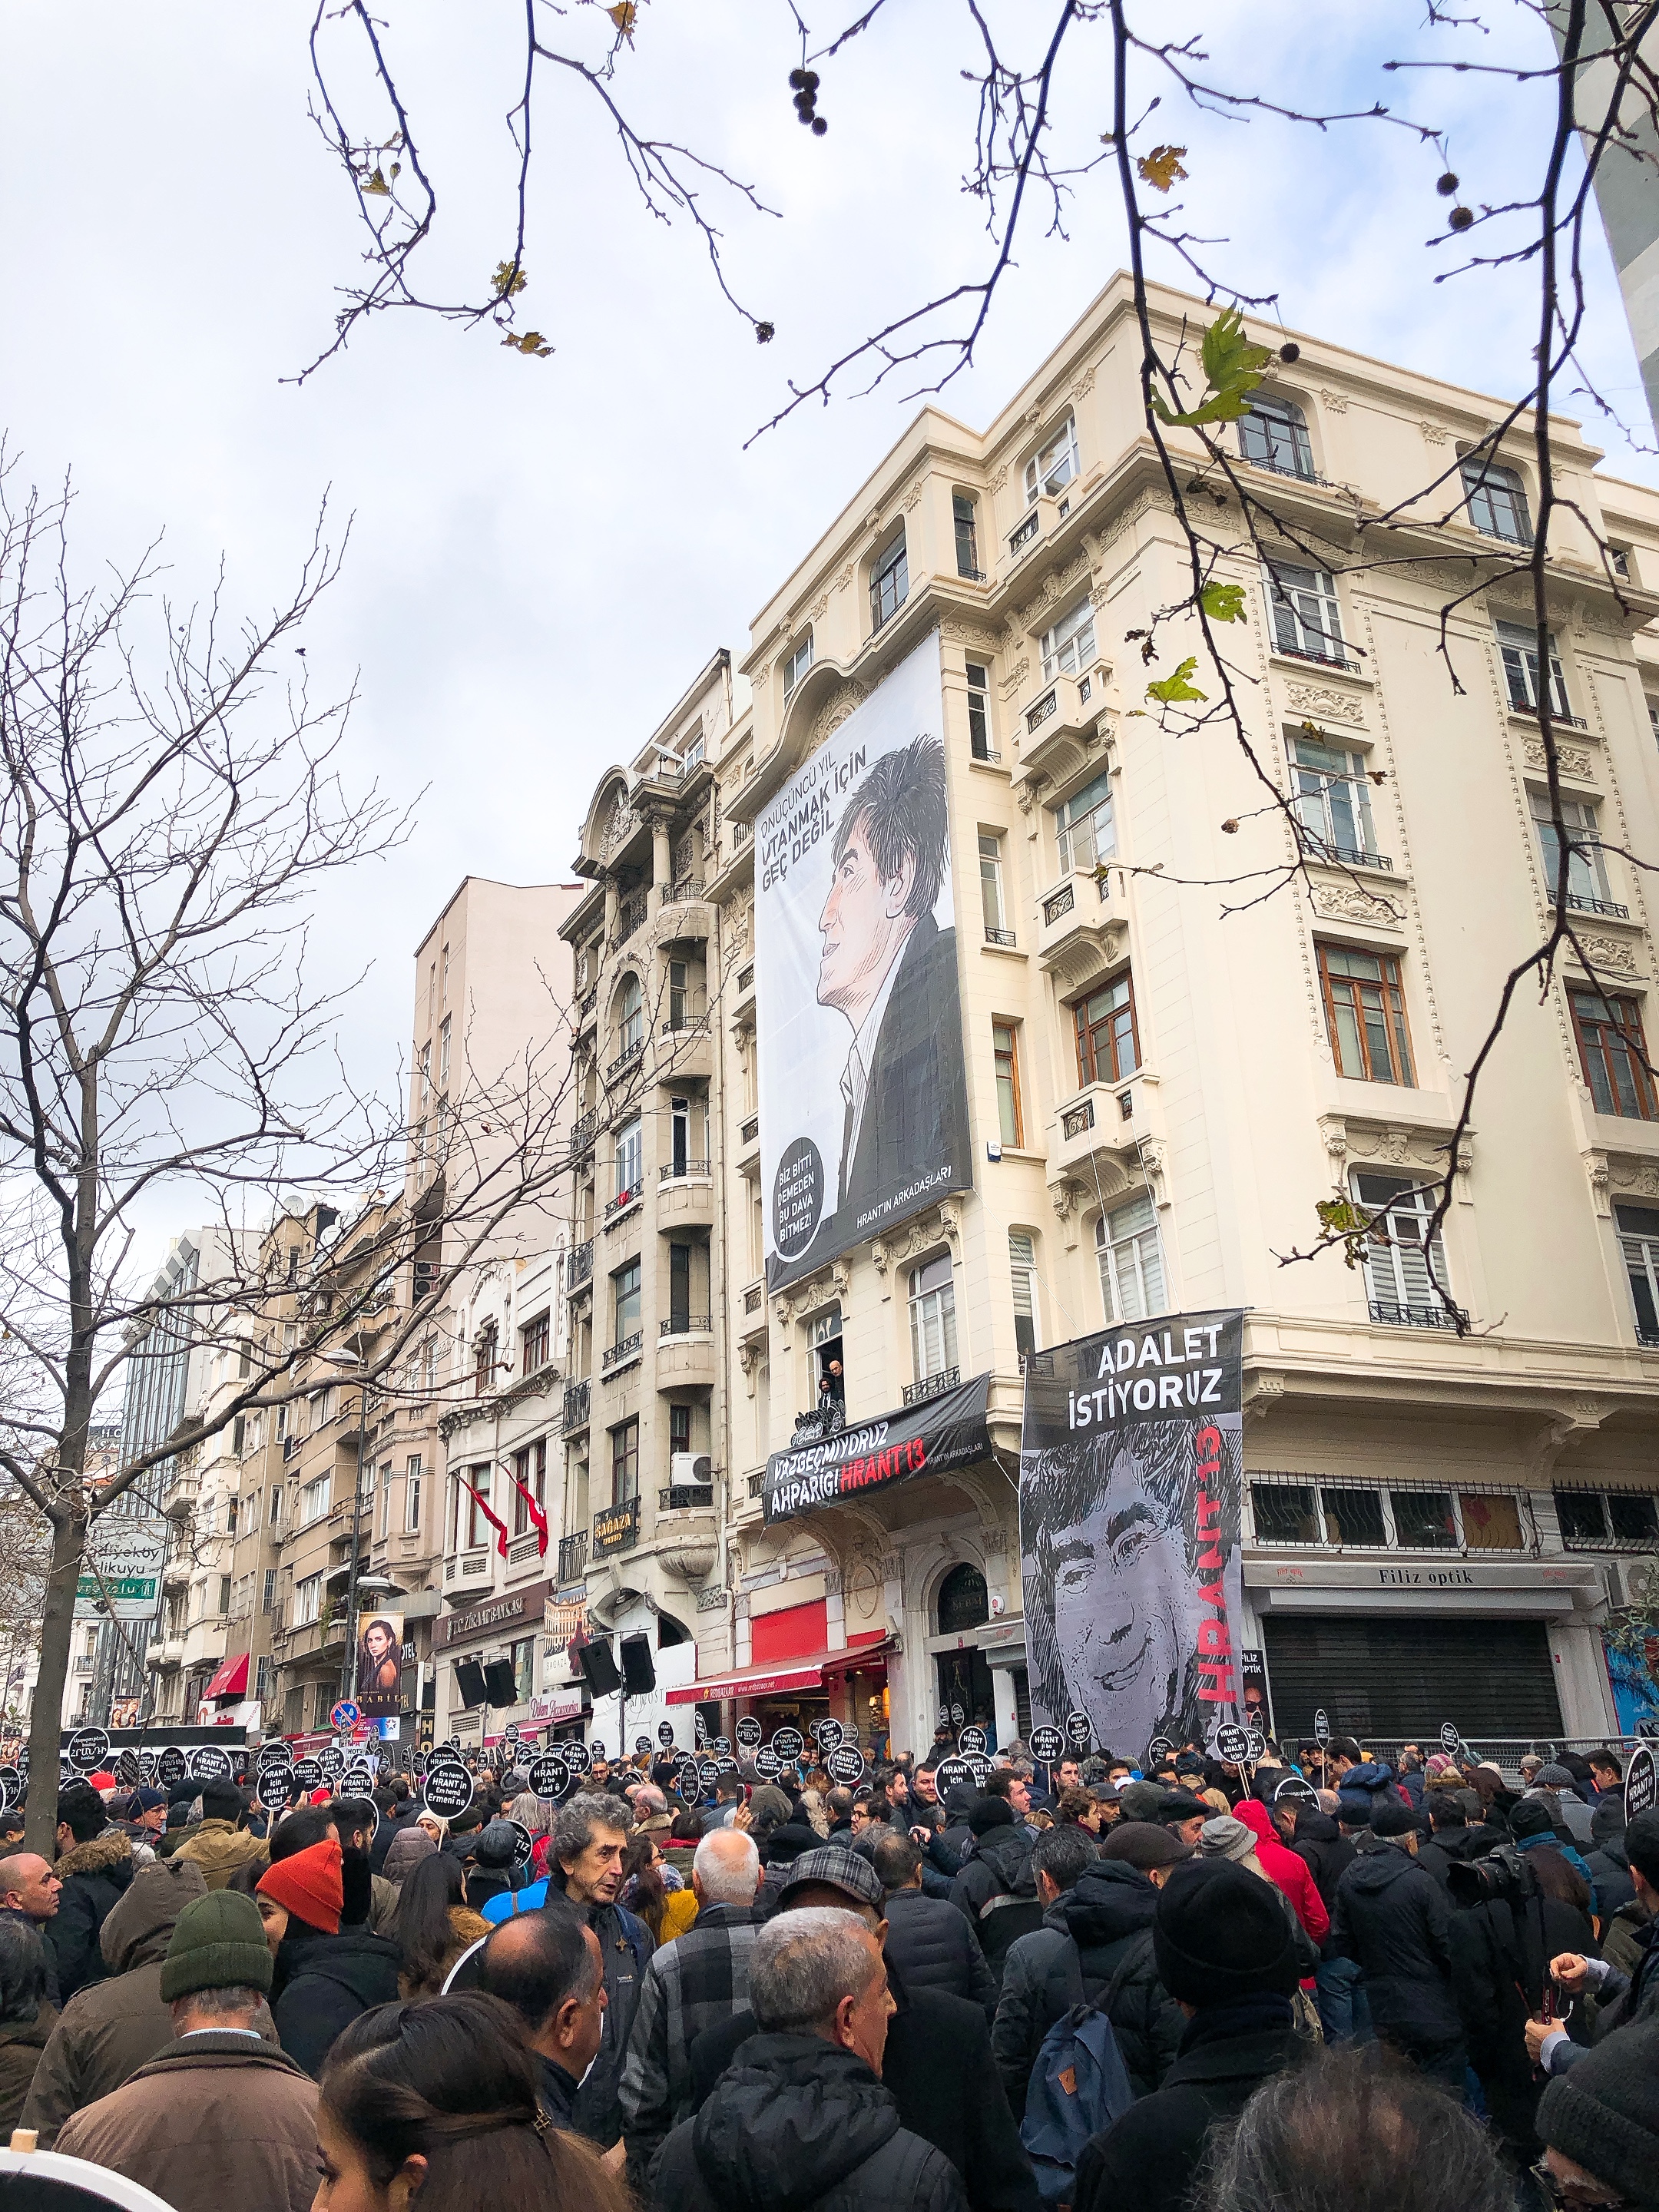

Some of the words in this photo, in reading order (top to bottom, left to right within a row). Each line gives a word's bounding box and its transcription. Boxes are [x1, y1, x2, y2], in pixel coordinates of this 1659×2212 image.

[761, 765, 816, 838] ONÜÇÜNCÜ
[819, 751, 836, 777] YIL
[762, 780, 830, 866] UTANMAK
[835, 745, 866, 794] İÇİN
[763, 853, 787, 892] GEÇ
[793, 809, 834, 865] DEĞİL
[779, 1167, 791, 1187] BİZ
[793, 1150, 812, 1177] BİTTİ
[777, 1171, 814, 1207] DEMEDEN
[856, 1200, 892, 1229] HRANT'IN
[892, 1165, 952, 1208] ARKADAŞLARI
[779, 1207, 790, 1224] BU
[791, 1195, 813, 1215] DAVA
[780, 1213, 812, 1242] BİTMEZ!
[1098, 1323, 1224, 1379] ADALET
[1069, 1368, 1223, 1429] İSTİYORUZ
[774, 1421, 889, 1482] VAZGEÇMİYORUZ
[949, 1442, 984, 1459] ARKADAŞLARI
[1197, 1426, 1221, 1482] 13
[771, 1469, 839, 1515] AHPARİG!
[840, 1449, 901, 1492] HRANT
[904, 1438, 926, 1470] 13
[1379, 1569, 1421, 1584] Filiz
[1429, 1569, 1473, 1586] optik
[1197, 1491, 1237, 1703] HRANT
[821, 1722, 836, 1731] HRANT
[1220, 1729, 1240, 1737] HRANT
[823, 1734, 839, 1743] ADALET
[963, 1735, 983, 1744] HRANT
[1224, 1744, 1245, 1753] ADALET
[197, 1757, 219, 1767] HRANT
[320, 1753, 340, 1761] HRANT
[834, 1754, 854, 1763] HRANT
[541, 1761, 546, 1770] ji
[942, 1766, 967, 1774] HRANT
[265, 1768, 288, 1779] HRANT
[534, 1767, 564, 1778] HRANT
[270, 1779, 282, 1787] için
[432, 1777, 459, 1788] HRANT
[460, 1781, 467, 1790] in
[538, 1785, 553, 1793] dad
[1629, 1777, 1648, 1802] HRANT
[263, 1786, 290, 1798] ADALET
[428, 1793, 455, 1804] Ermenî
[268, 1797, 283, 1806] için!
